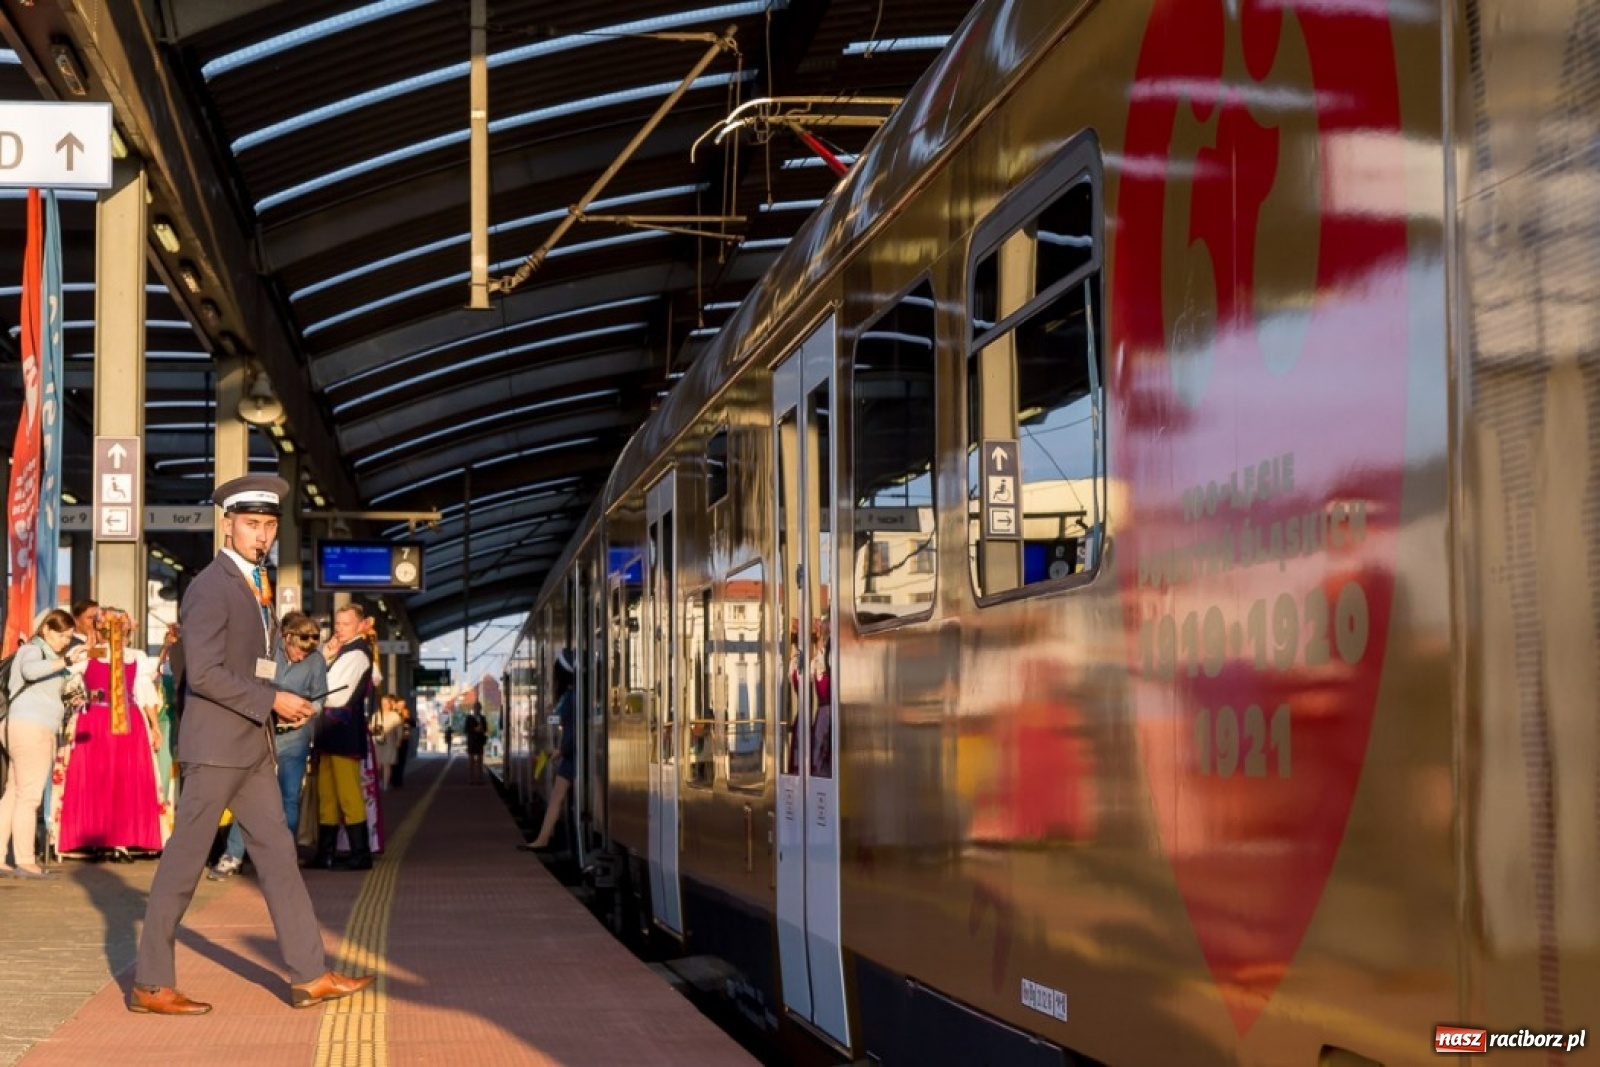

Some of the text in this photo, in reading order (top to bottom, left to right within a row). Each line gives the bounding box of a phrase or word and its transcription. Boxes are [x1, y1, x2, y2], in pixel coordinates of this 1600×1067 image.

[60, 515, 75, 524] or
[193, 513, 202, 524] 7
[401, 547, 411, 560] 7
[1194, 703, 1292, 779] 1921
